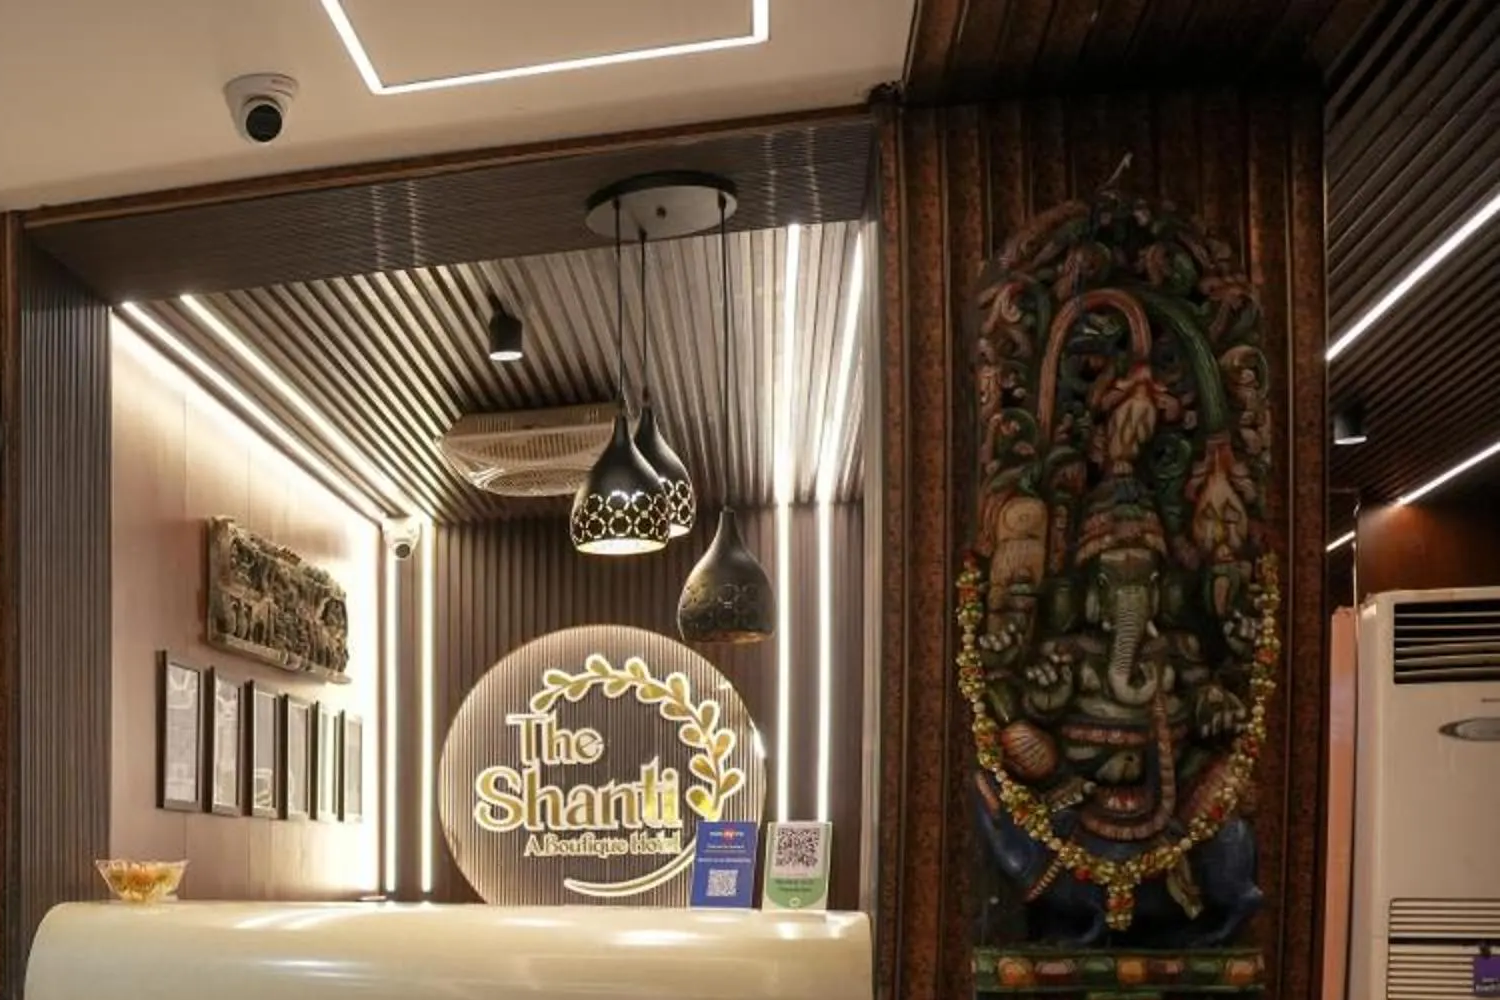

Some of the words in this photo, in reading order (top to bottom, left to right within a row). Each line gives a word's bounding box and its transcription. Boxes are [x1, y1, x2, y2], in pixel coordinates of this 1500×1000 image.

[506, 711, 604, 764] The
[475, 757, 683, 831] Shanti
[524, 834, 543, 856] A
[543, 832, 629, 858] Boutique
